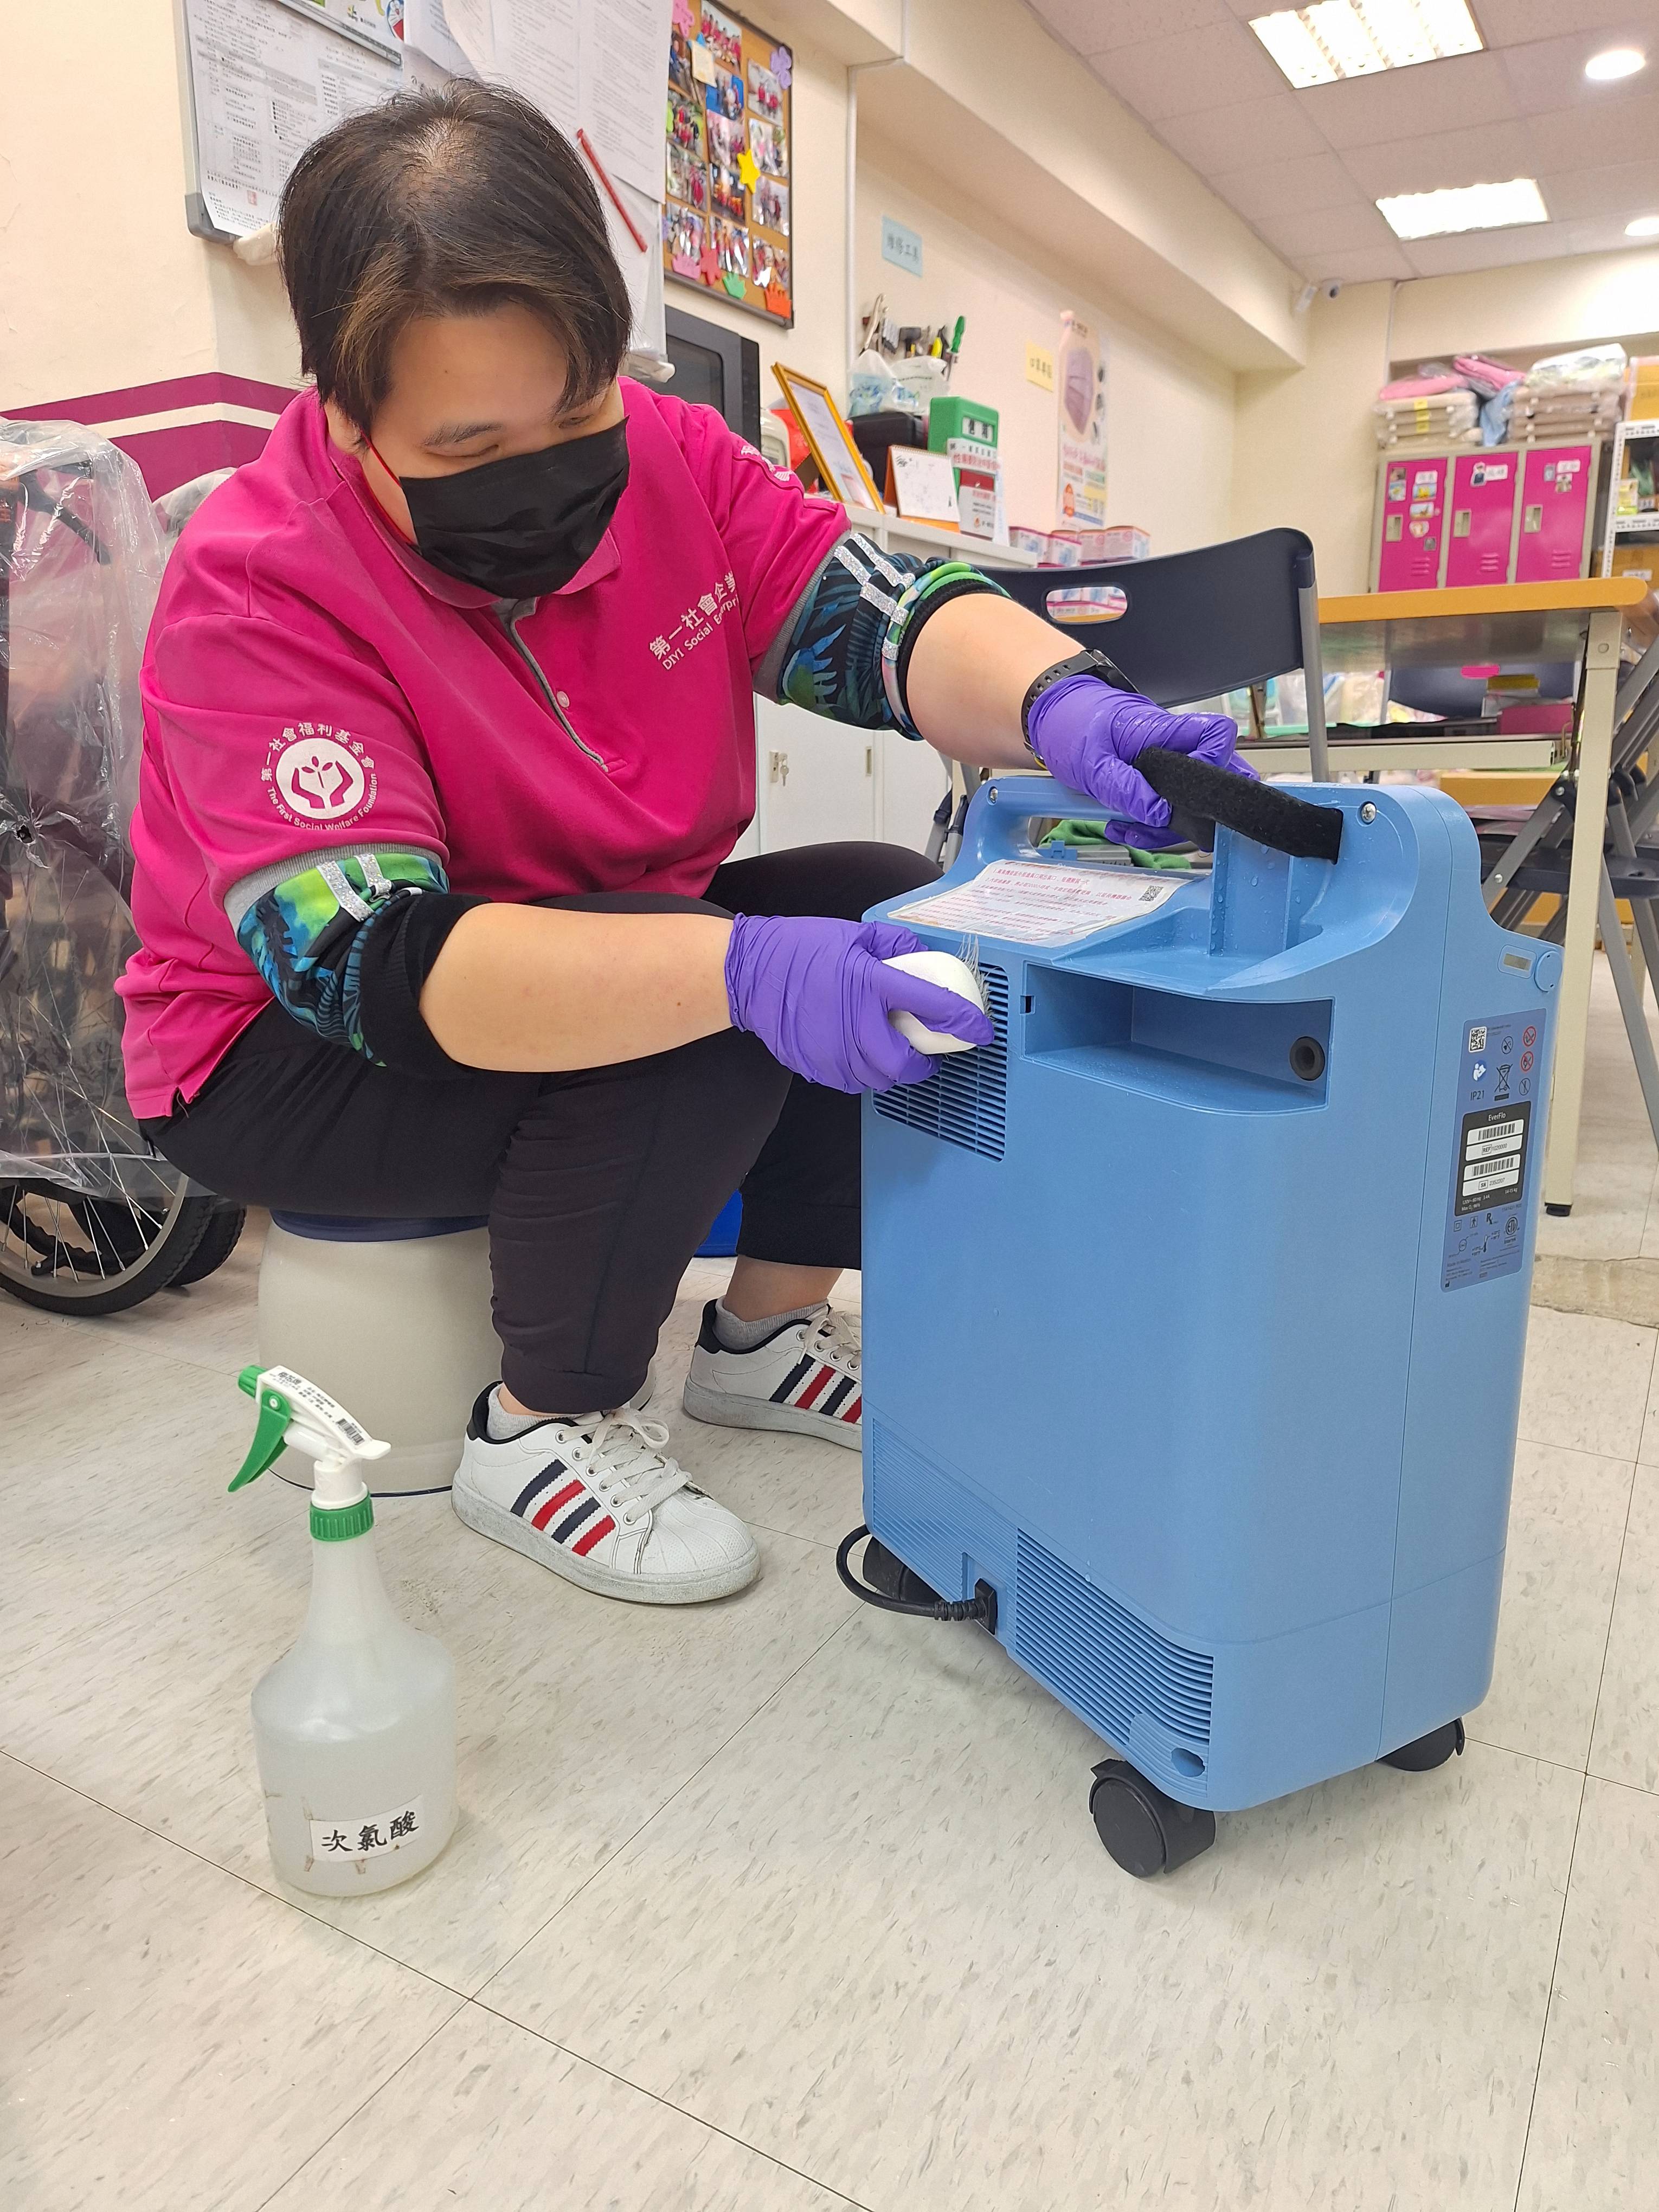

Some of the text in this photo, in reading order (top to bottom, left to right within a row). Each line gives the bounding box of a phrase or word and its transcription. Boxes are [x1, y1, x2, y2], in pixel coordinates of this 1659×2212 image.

[661, 647, 685, 670] DIYI
[684, 622, 714, 651] Social
[260, 722, 376, 783] 第一社會福利基金會
[267, 773, 378, 831] The First Social Welfare Foundation
[1470, 1090, 1484, 1101] IP21
[1488, 1112, 1507, 1122] EverFlo
[321, 1810, 420, 1852] 次氯酸
